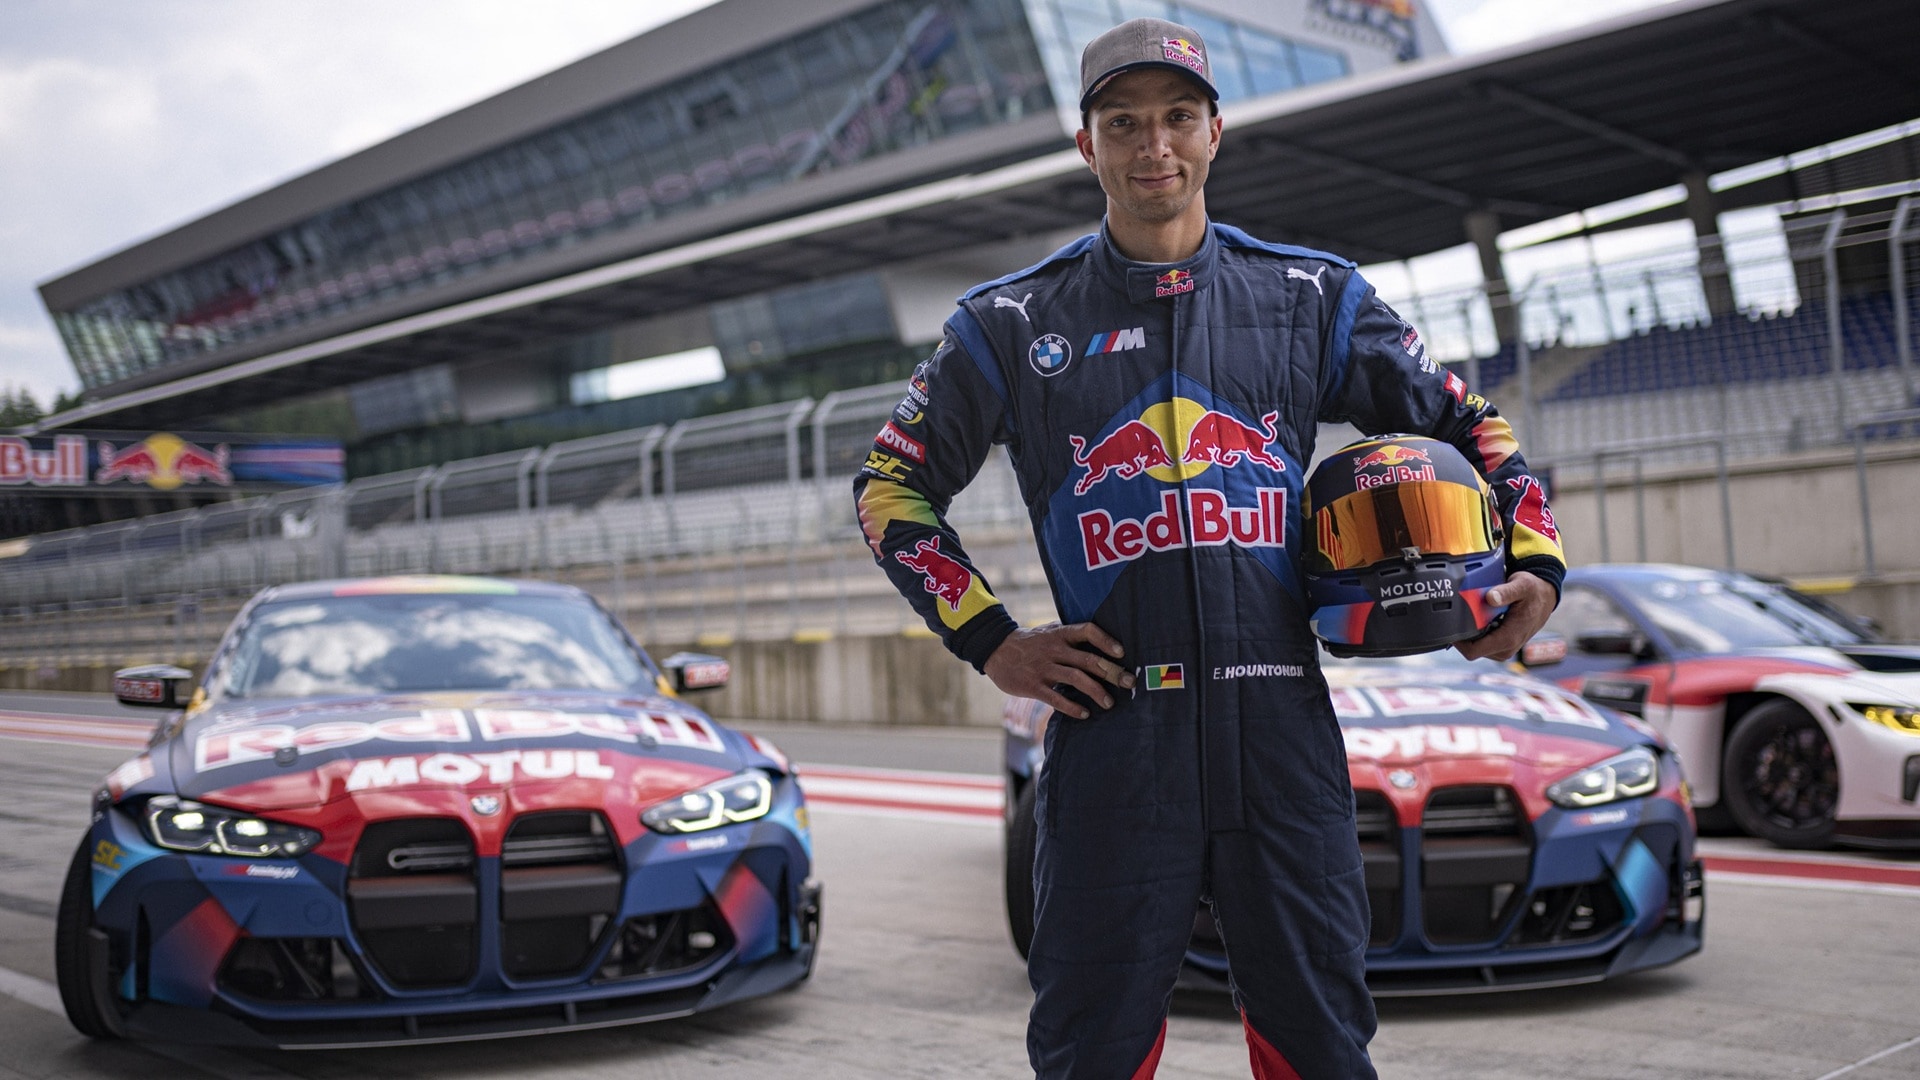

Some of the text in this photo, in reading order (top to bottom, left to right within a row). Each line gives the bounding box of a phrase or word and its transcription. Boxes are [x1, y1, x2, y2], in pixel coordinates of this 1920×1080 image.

[1165, 48, 1203, 74] Red Bull
[1156, 279, 1193, 297] Red Bull
[1033, 335, 1065, 351] BMW
[0, 435, 87, 485] Bull
[864, 450, 912, 480] SC
[1355, 465, 1437, 491] Red Bull
[1078, 487, 1287, 571] Red Bull
[1380, 578, 1452, 598] MOTOLVR
[195, 708, 471, 773] Red
[478, 708, 726, 753] Bull
[1342, 725, 1517, 759] OTUL
[346, 750, 614, 791] MOTUL
